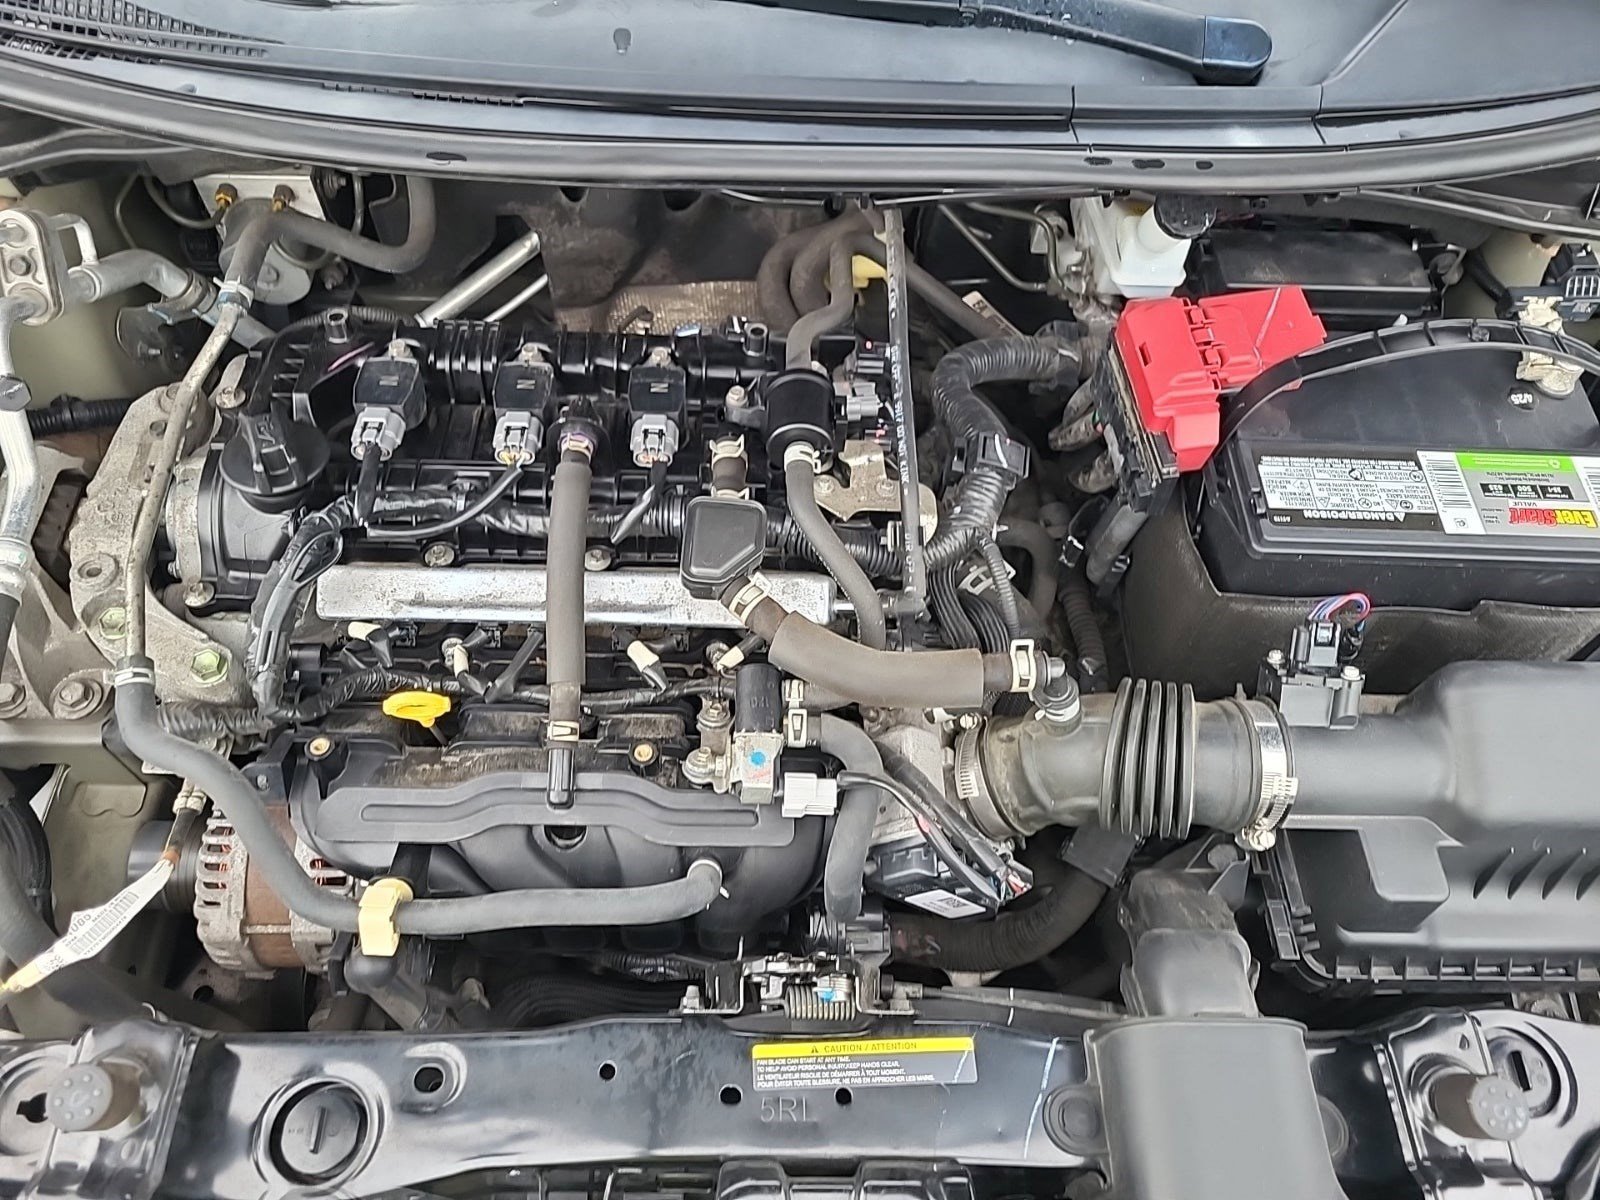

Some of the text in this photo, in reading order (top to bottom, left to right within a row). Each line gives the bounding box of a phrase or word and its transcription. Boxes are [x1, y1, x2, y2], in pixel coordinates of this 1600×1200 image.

[898, 440, 906, 457] NOT
[900, 460, 909, 484] KINK
[1303, 510, 1394, 521] DANGER/POISON
[1509, 508, 1598, 528] EverStart
[824, 1044, 862, 1053] CAUTION
[871, 1042, 917, 1051] ATTENTION
